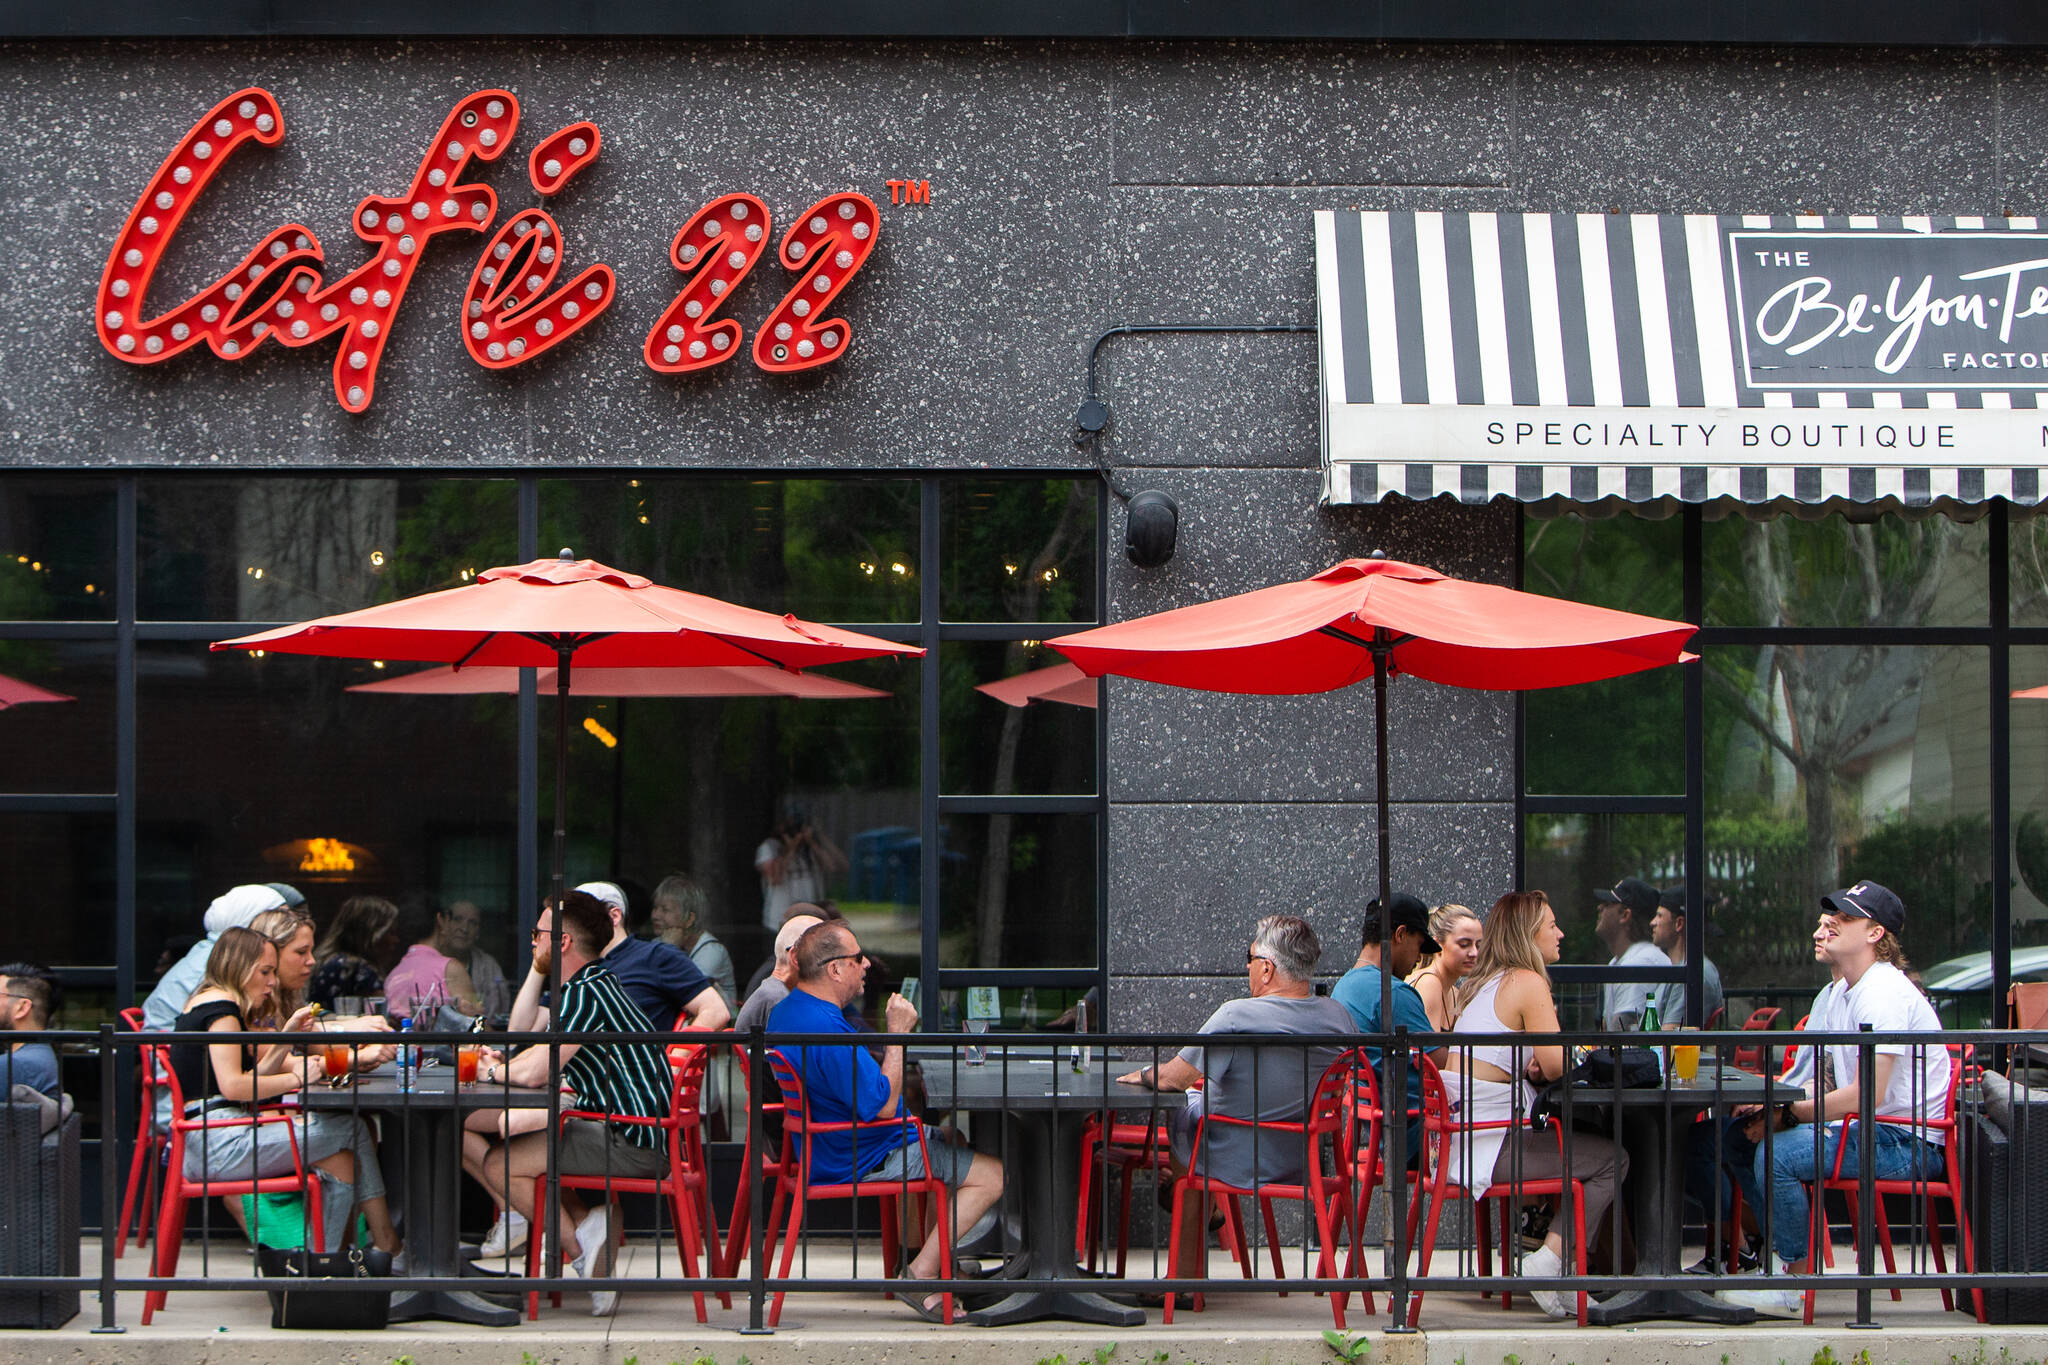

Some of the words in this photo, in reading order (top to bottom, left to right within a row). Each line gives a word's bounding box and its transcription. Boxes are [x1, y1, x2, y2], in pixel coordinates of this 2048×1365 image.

[96, 87, 615, 412] Café
[643, 192, 881, 374] 22
[1755, 251, 1811, 267] THE
[1487, 422, 1718, 447] SPECIALTY
[1742, 423, 1955, 448] BOUTIQUE
